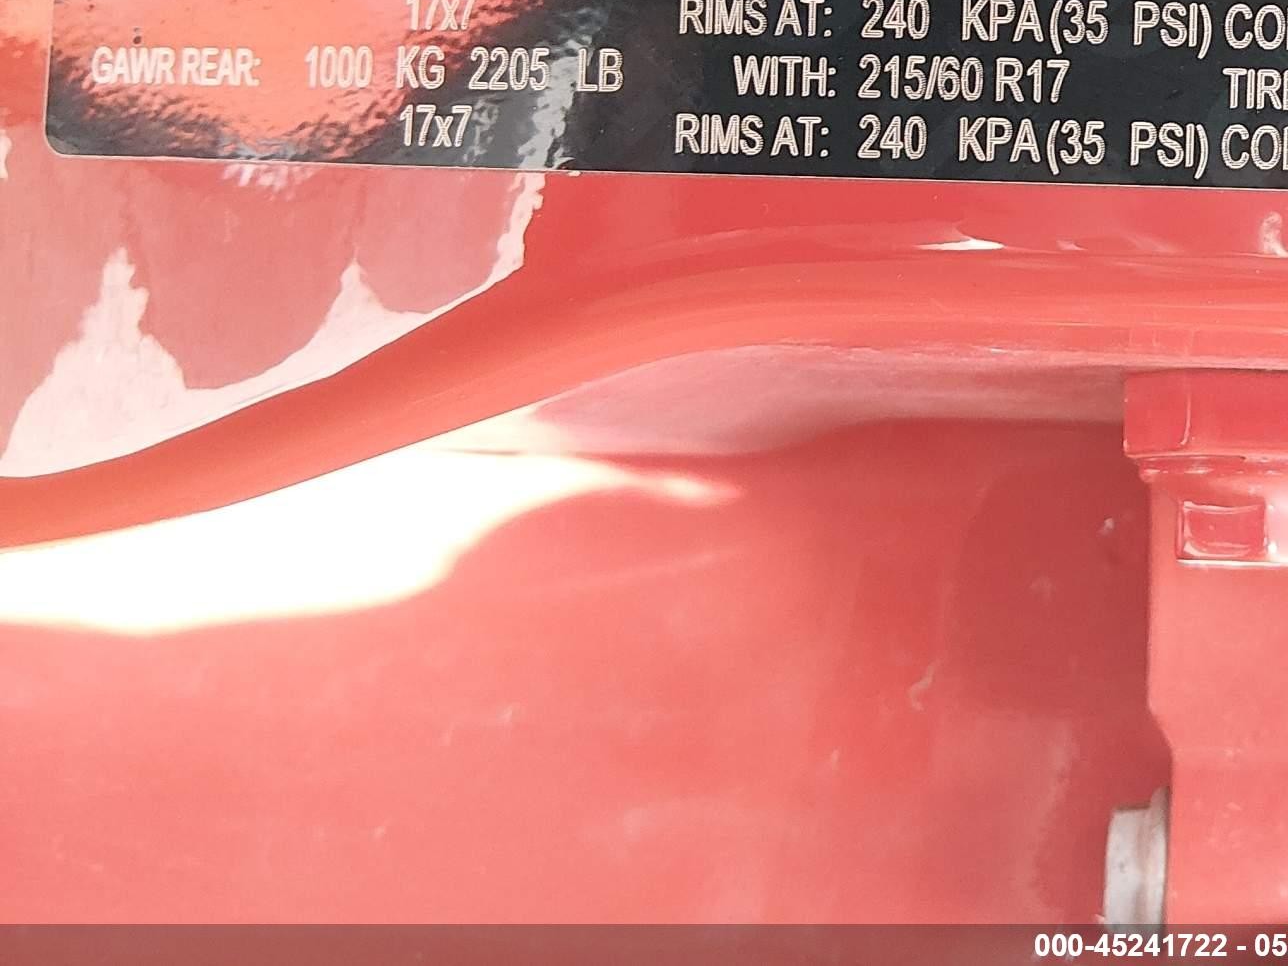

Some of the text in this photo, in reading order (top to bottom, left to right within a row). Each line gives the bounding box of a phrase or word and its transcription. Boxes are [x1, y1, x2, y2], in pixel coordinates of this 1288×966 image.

[1132, 0, 1211, 59] PSI)
[92, 46, 173, 85] GAWR
[177, 47, 260, 87] REAR:
[304, 47, 374, 89] 1000
[396, 46, 446, 89] KG
[469, 47, 549, 91] 2205
[576, 47, 624, 92] LB
[734, 54, 837, 98] WITH:
[858, 55, 984, 101] 215/60
[995, 56, 1070, 103] R17
[399, 104, 473, 148] 17x7
[675, 113, 764, 157] RIMS
[770, 114, 830, 158] AT:
[857, 114, 927, 160] 240
[1130, 121, 1208, 179] PSI)
